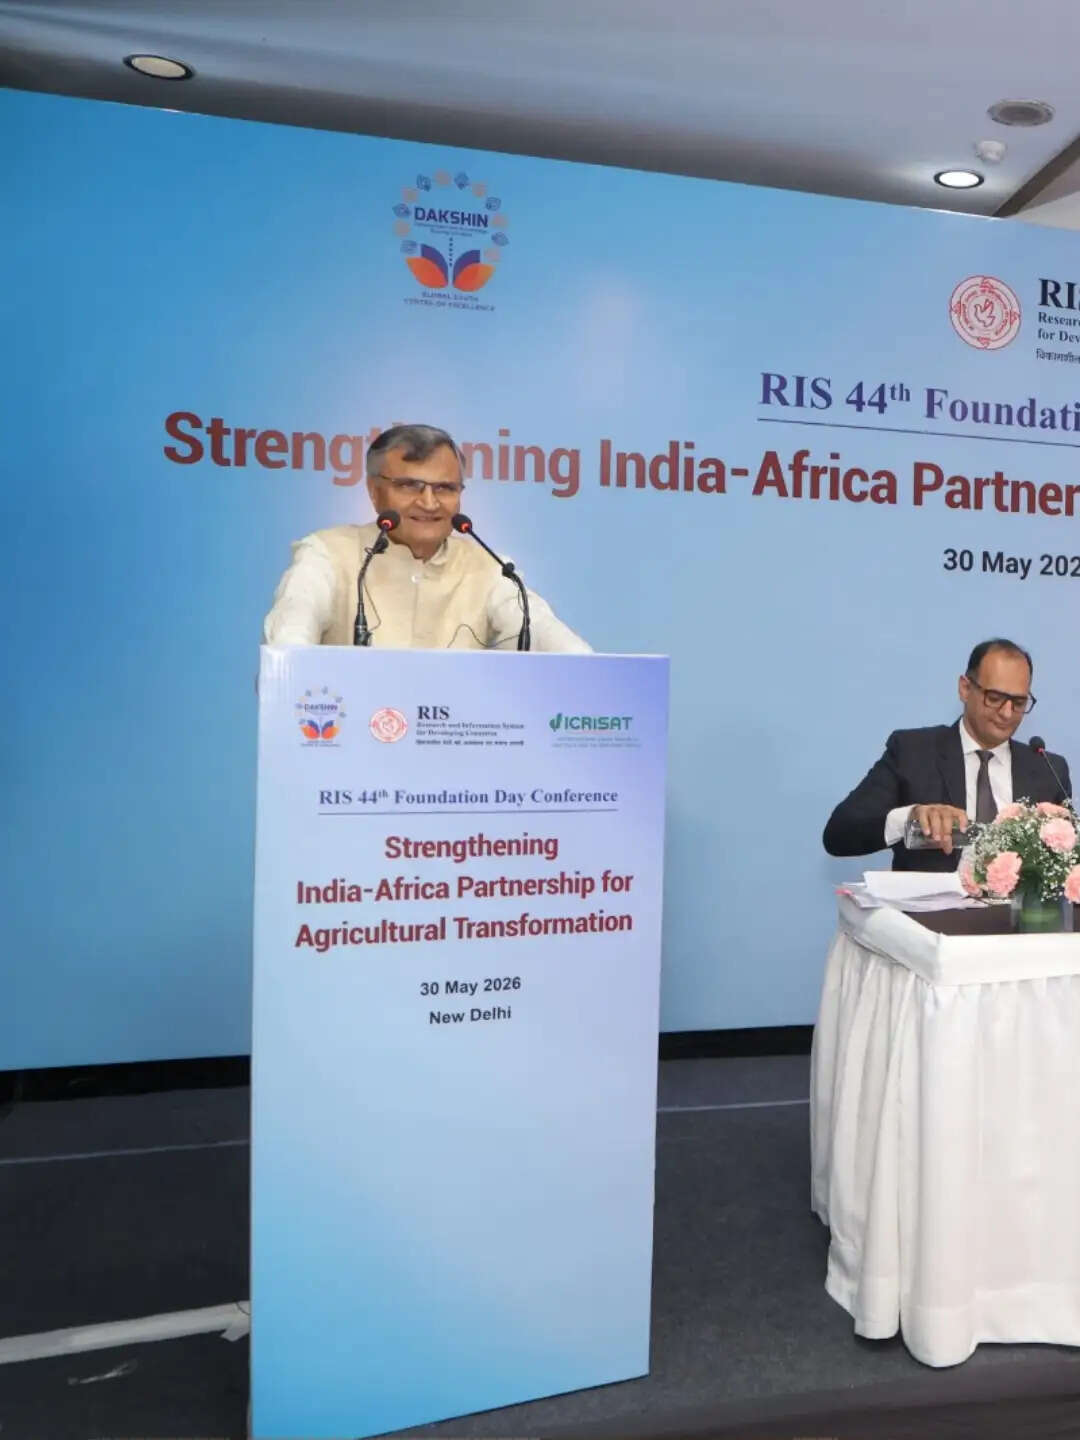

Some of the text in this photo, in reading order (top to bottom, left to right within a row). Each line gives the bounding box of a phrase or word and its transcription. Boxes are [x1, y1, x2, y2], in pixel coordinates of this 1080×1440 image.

[414, 207, 489, 228] DAKSHIN
[1038, 327, 1055, 341] for
[759, 371, 833, 411] RIS
[845, 380, 911, 415] 44th
[164, 410, 581, 499] Strengning
[601, 438, 897, 505] India-Africa
[943, 548, 974, 572] 30
[982, 551, 1032, 580] May
[417, 706, 450, 720] RIS
[564, 715, 633, 732] ICRISAT
[319, 788, 618, 807] RIS 44th Foundation Day Conference
[384, 832, 559, 863] Strengthening
[296, 870, 634, 905] India-Africa Partnership for
[295, 909, 633, 953] Agricultural Transformation
[420, 977, 522, 999] 30 May 2026
[429, 1006, 512, 1026] New Delhi
